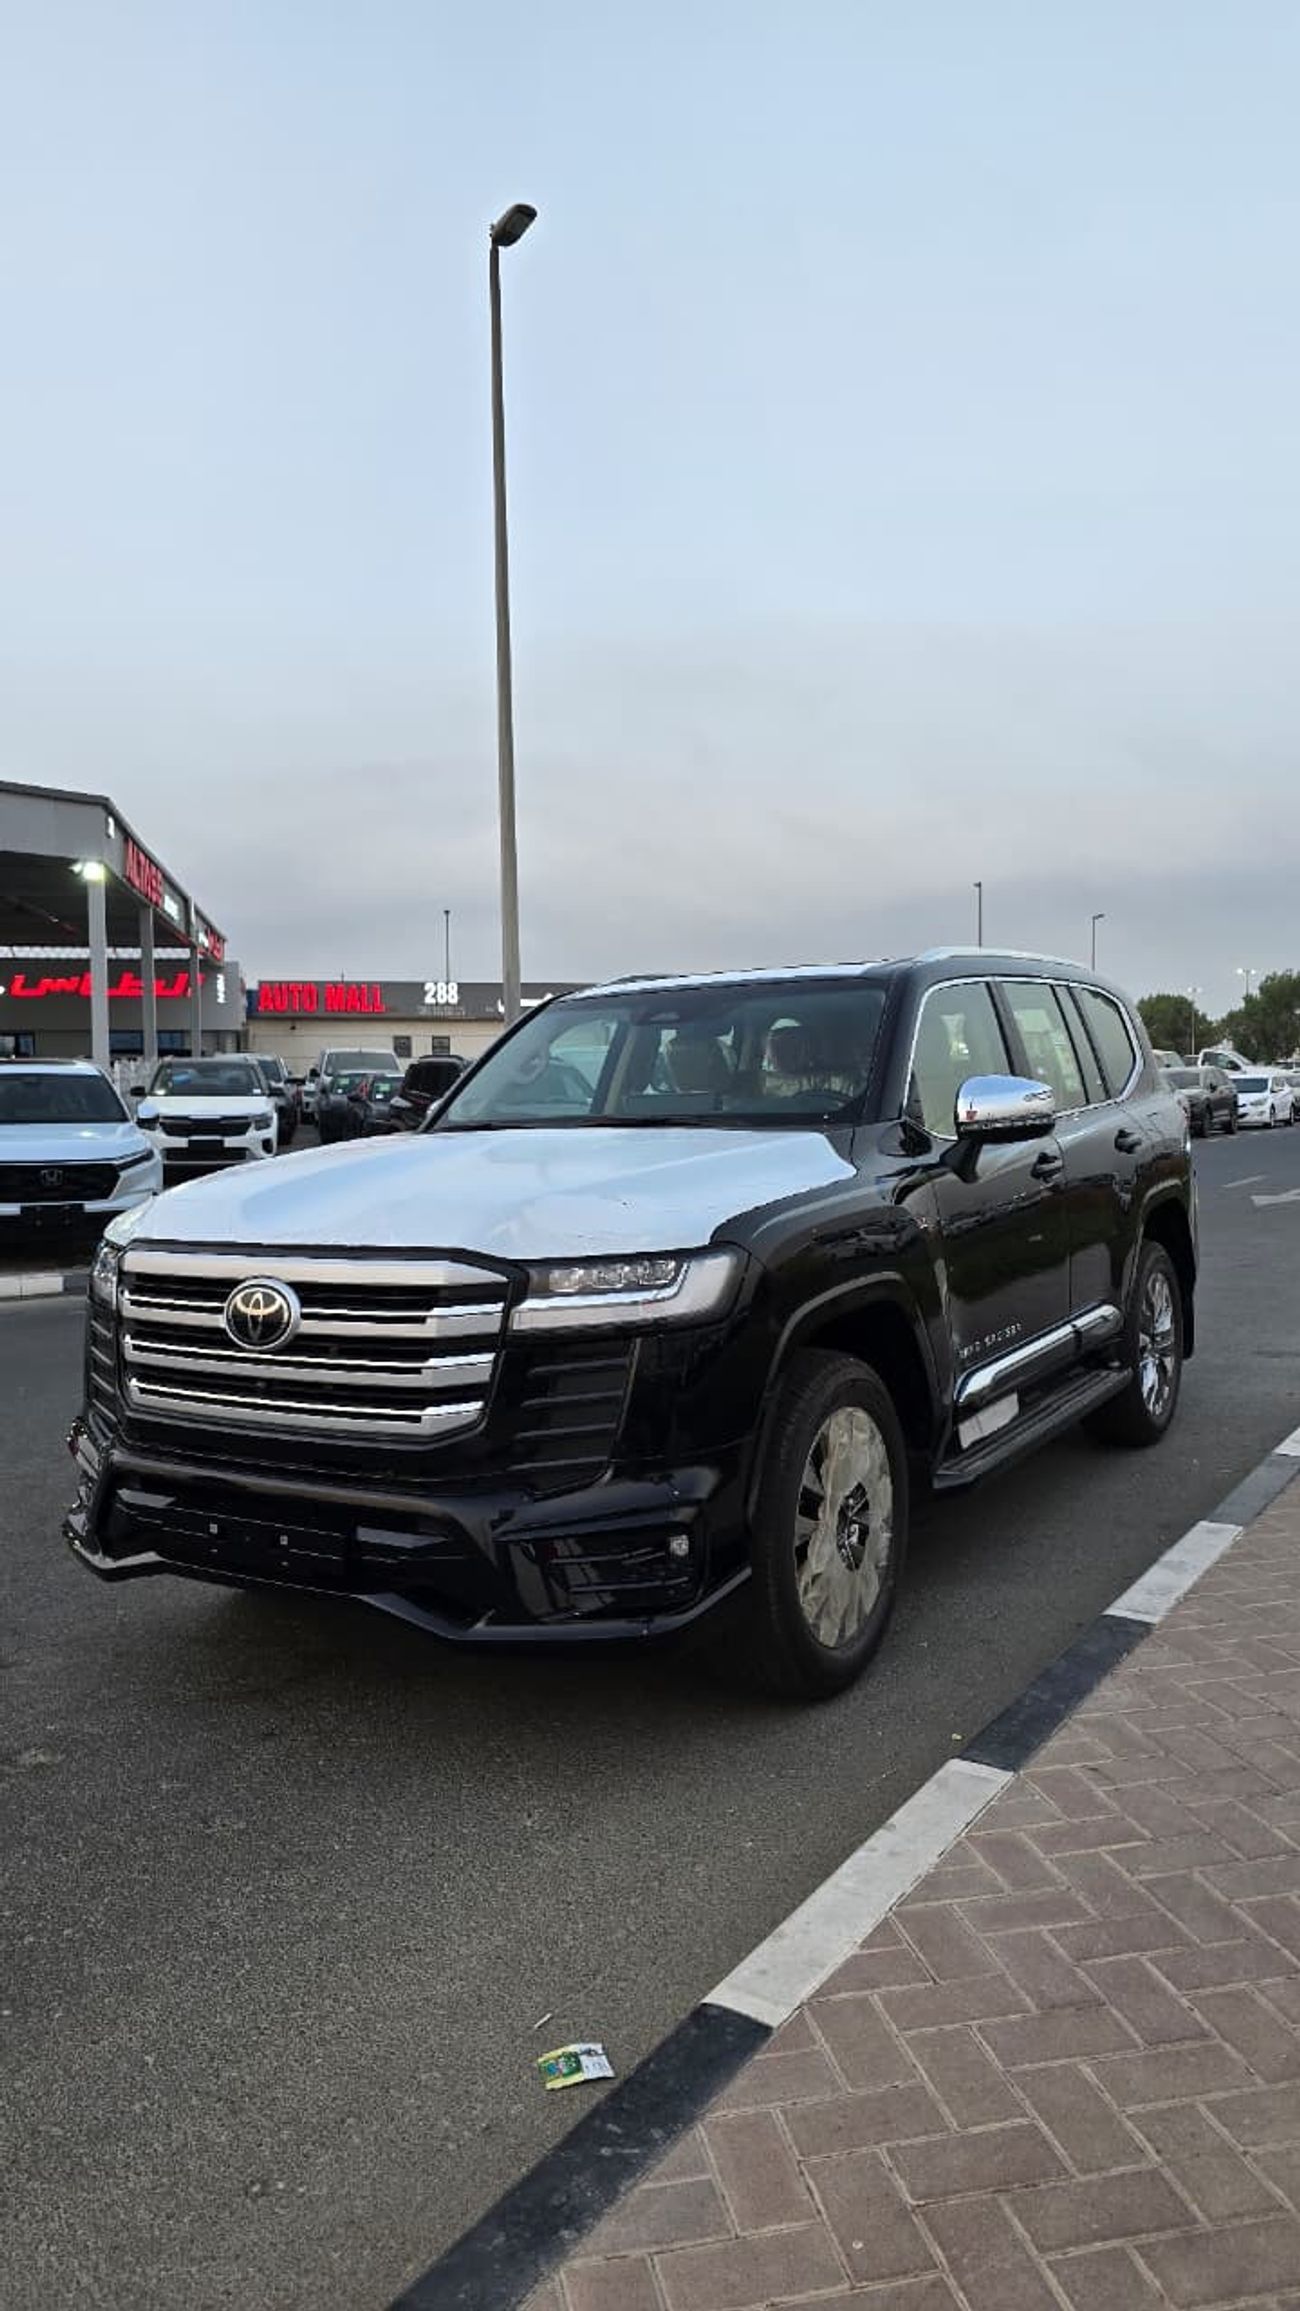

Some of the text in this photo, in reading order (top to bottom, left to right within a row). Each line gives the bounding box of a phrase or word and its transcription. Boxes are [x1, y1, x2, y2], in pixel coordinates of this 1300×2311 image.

[258, 982, 319, 1013] AUTO
[324, 983, 386, 1014] MALL
[423, 981, 459, 1005] 288
